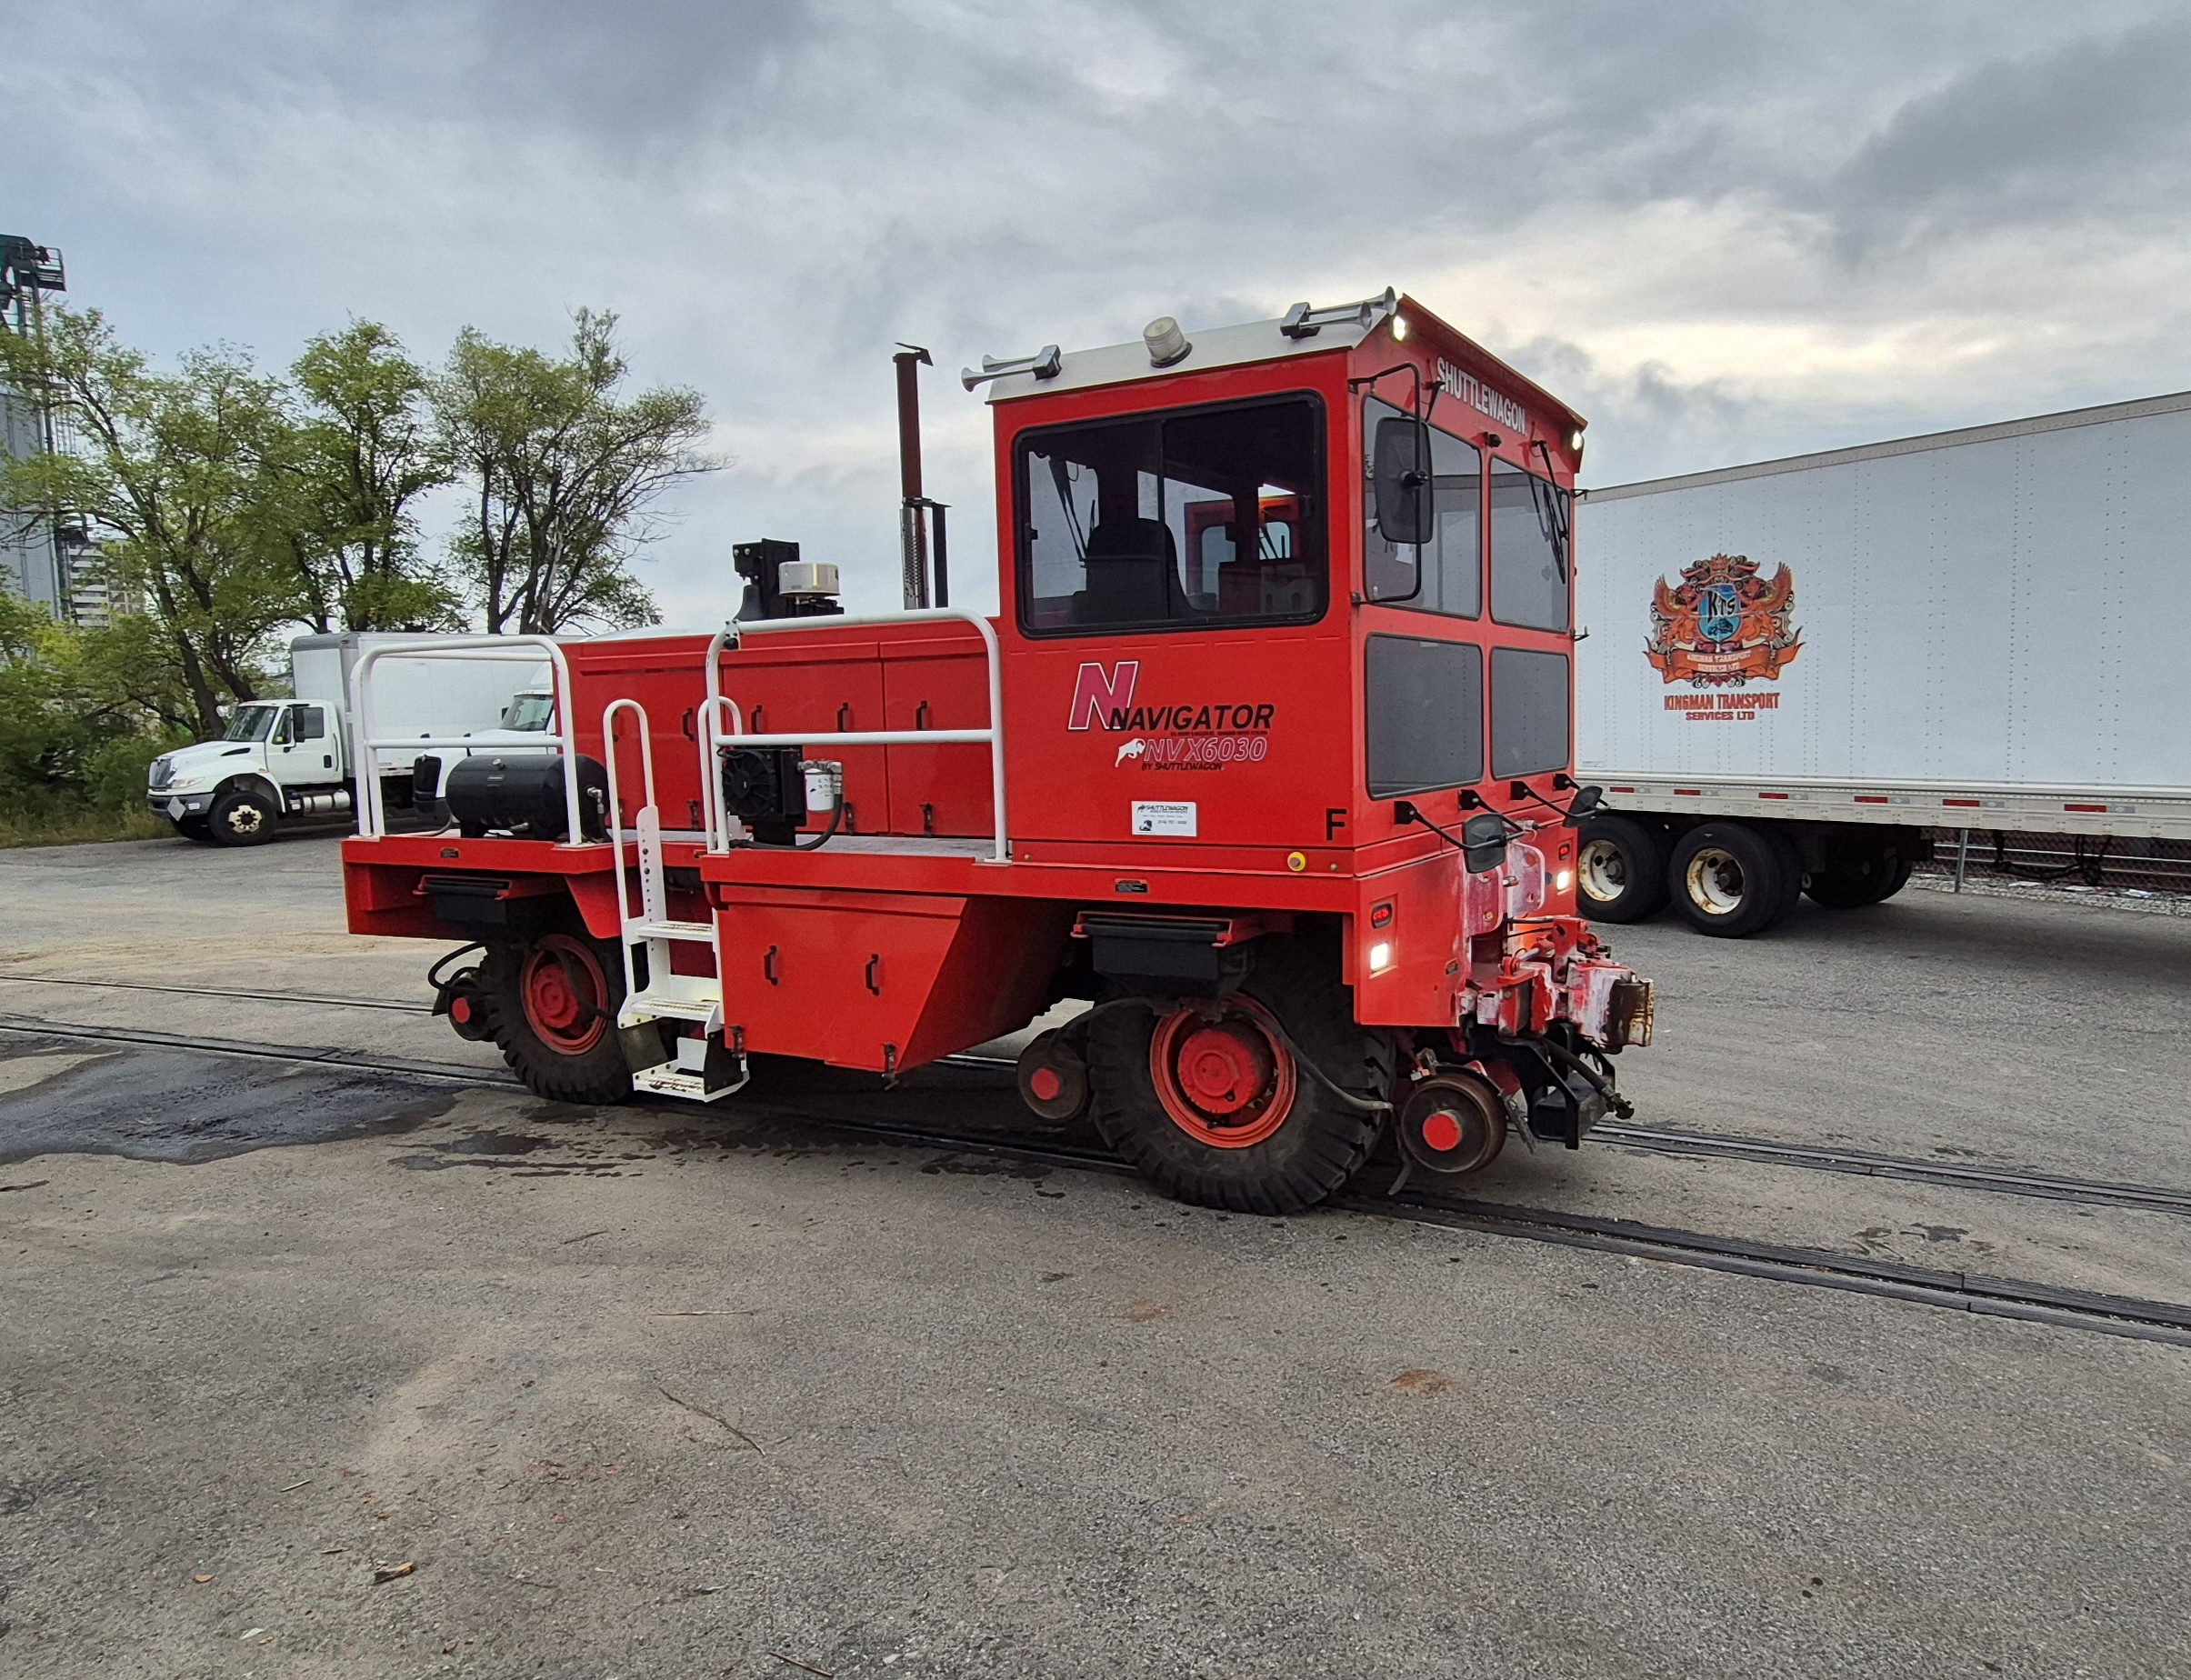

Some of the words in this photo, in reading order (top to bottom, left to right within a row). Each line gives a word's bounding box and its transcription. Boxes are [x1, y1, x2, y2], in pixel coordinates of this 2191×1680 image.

[1437, 356, 1526, 435] SHUTTLEWAGON
[1664, 695, 1714, 710] KINGMAN
[1716, 693, 1780, 709] TRANSPORT
[1109, 704, 1275, 730] NAVIGATOR
[1686, 711, 1734, 720] SERVICES
[1736, 711, 1756, 720] LTD
[1144, 736, 1267, 762] NVX6030
[1142, 762, 1152, 771] BY
[1155, 762, 1223, 771] SHUTTLEWAGON
[1326, 808, 1347, 841] F
